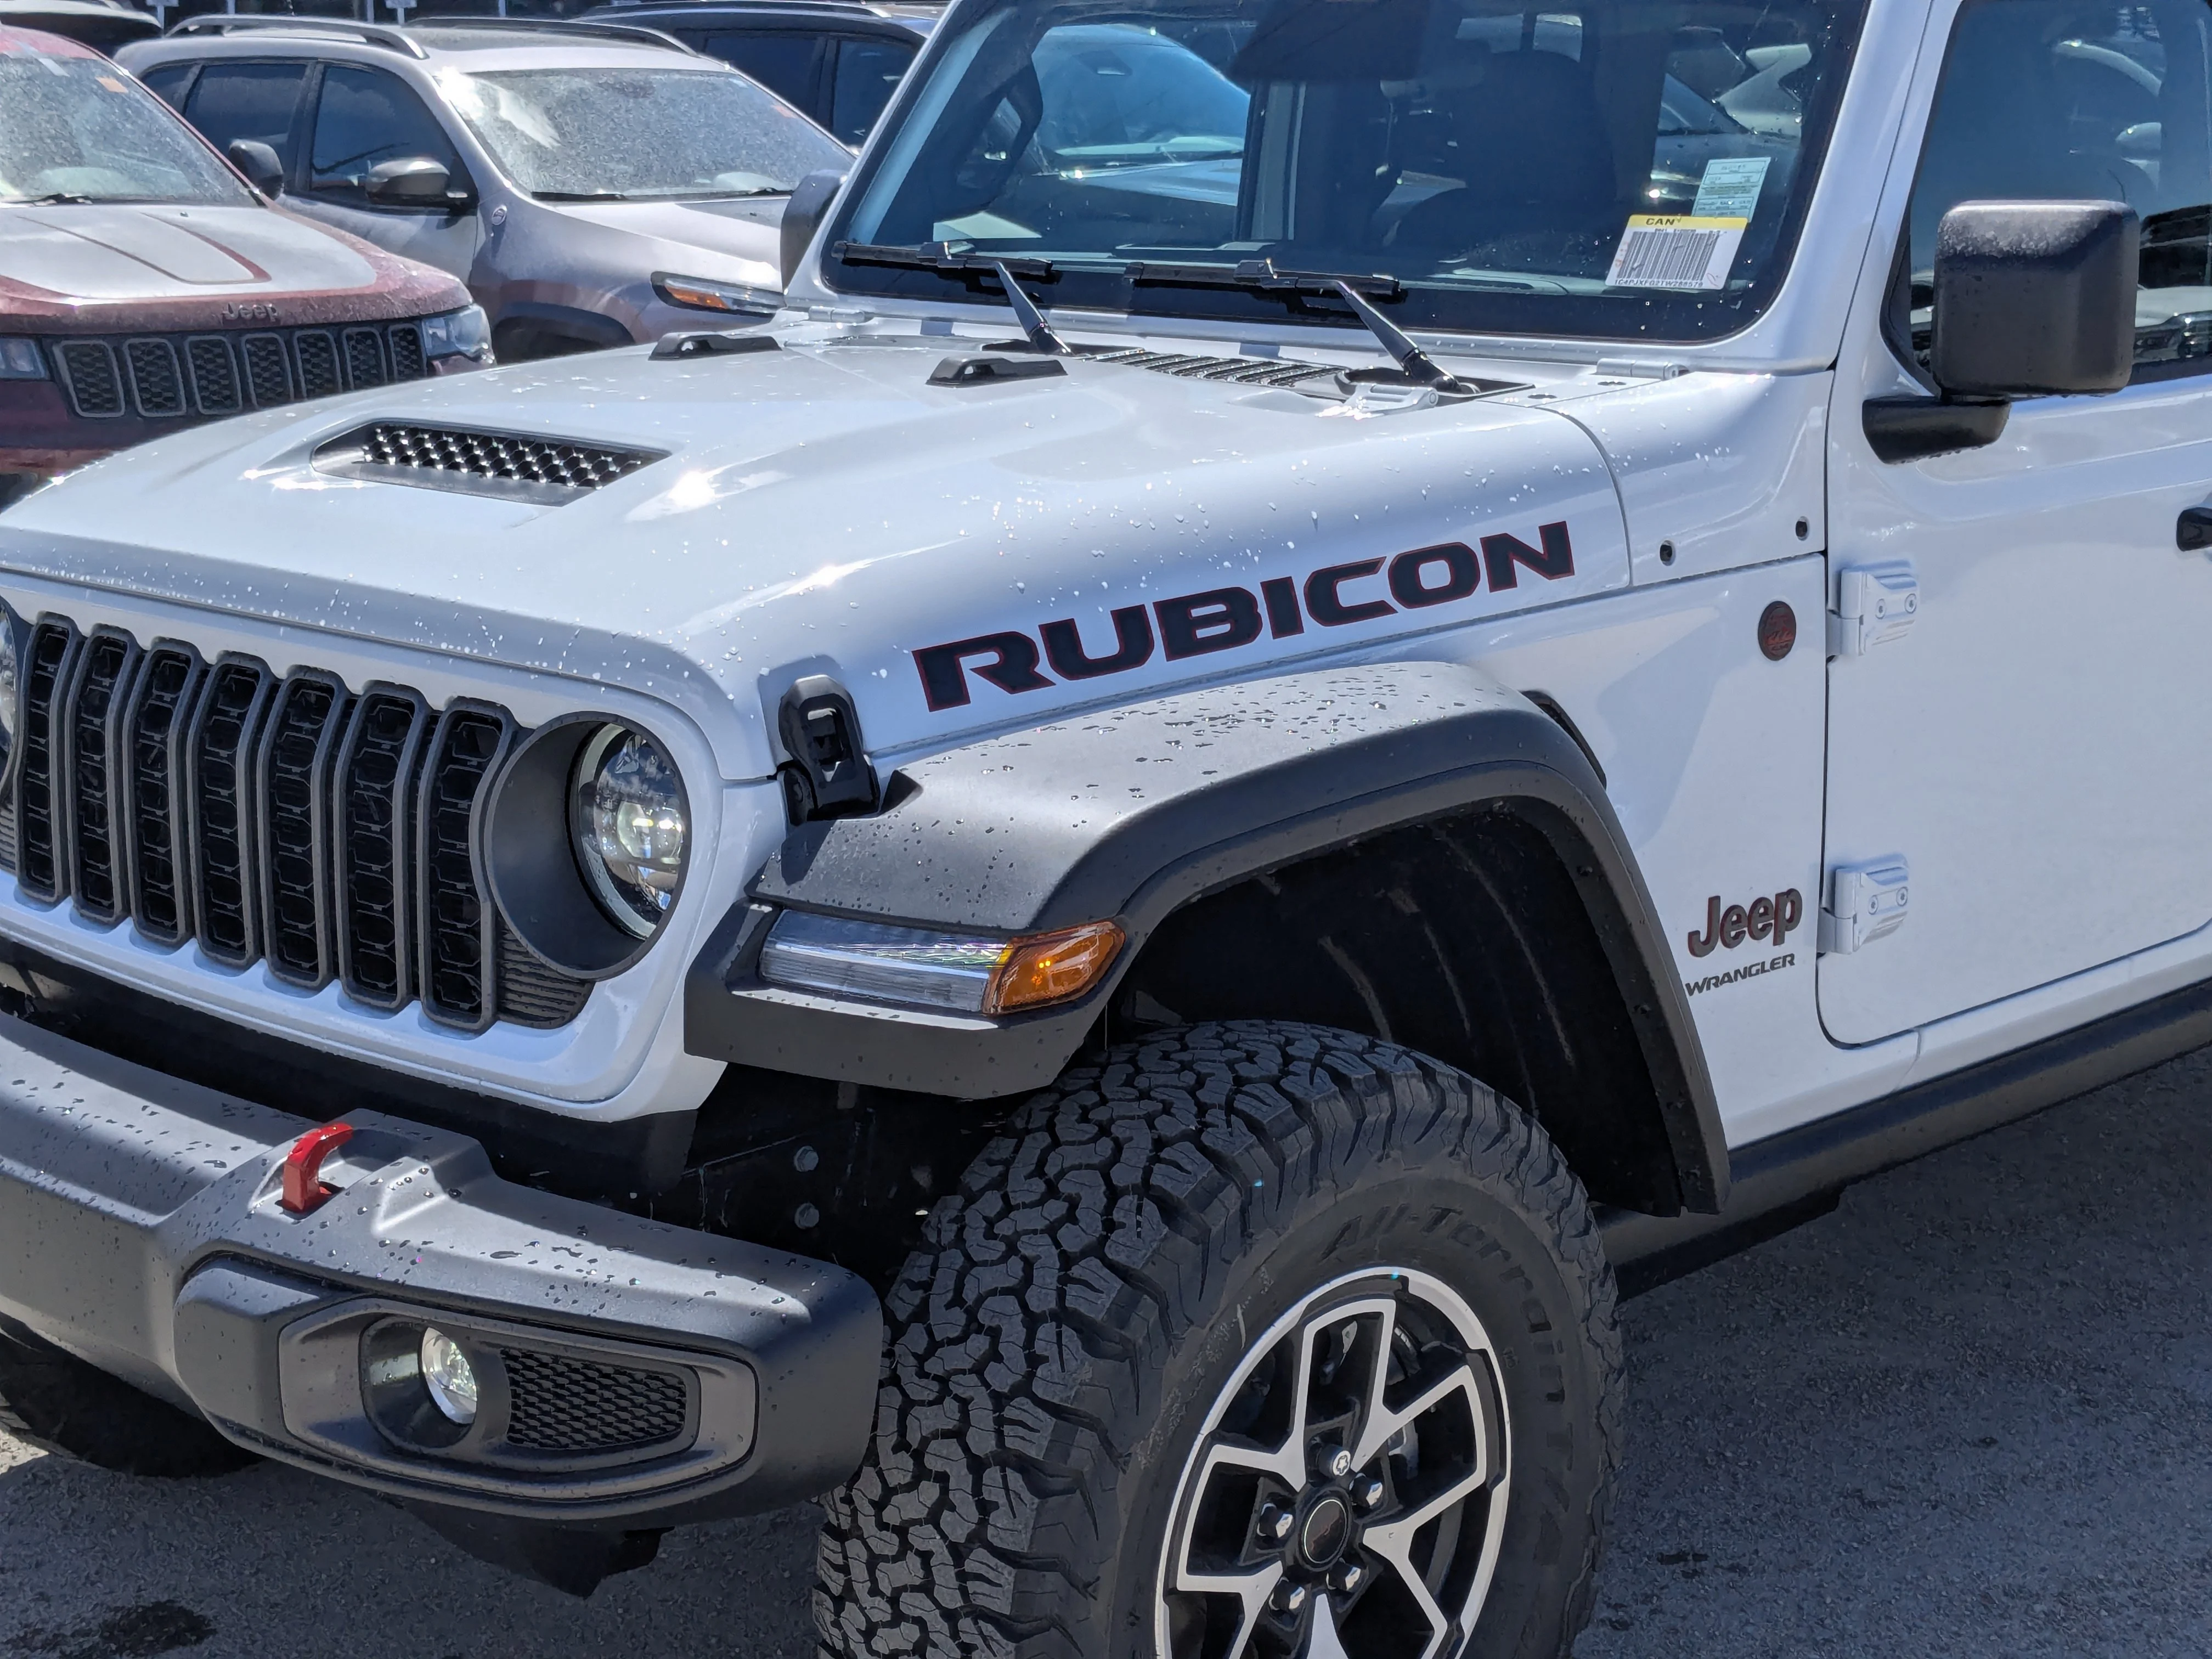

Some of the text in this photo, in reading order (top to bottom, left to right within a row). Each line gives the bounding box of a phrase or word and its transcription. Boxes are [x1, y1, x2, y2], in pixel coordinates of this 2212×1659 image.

[222, 301, 279, 322] Jeep
[911, 521, 1576, 713] RUBICON
[1688, 888, 1803, 957] Jeep
[1685, 953, 1795, 996] WRANGLER
